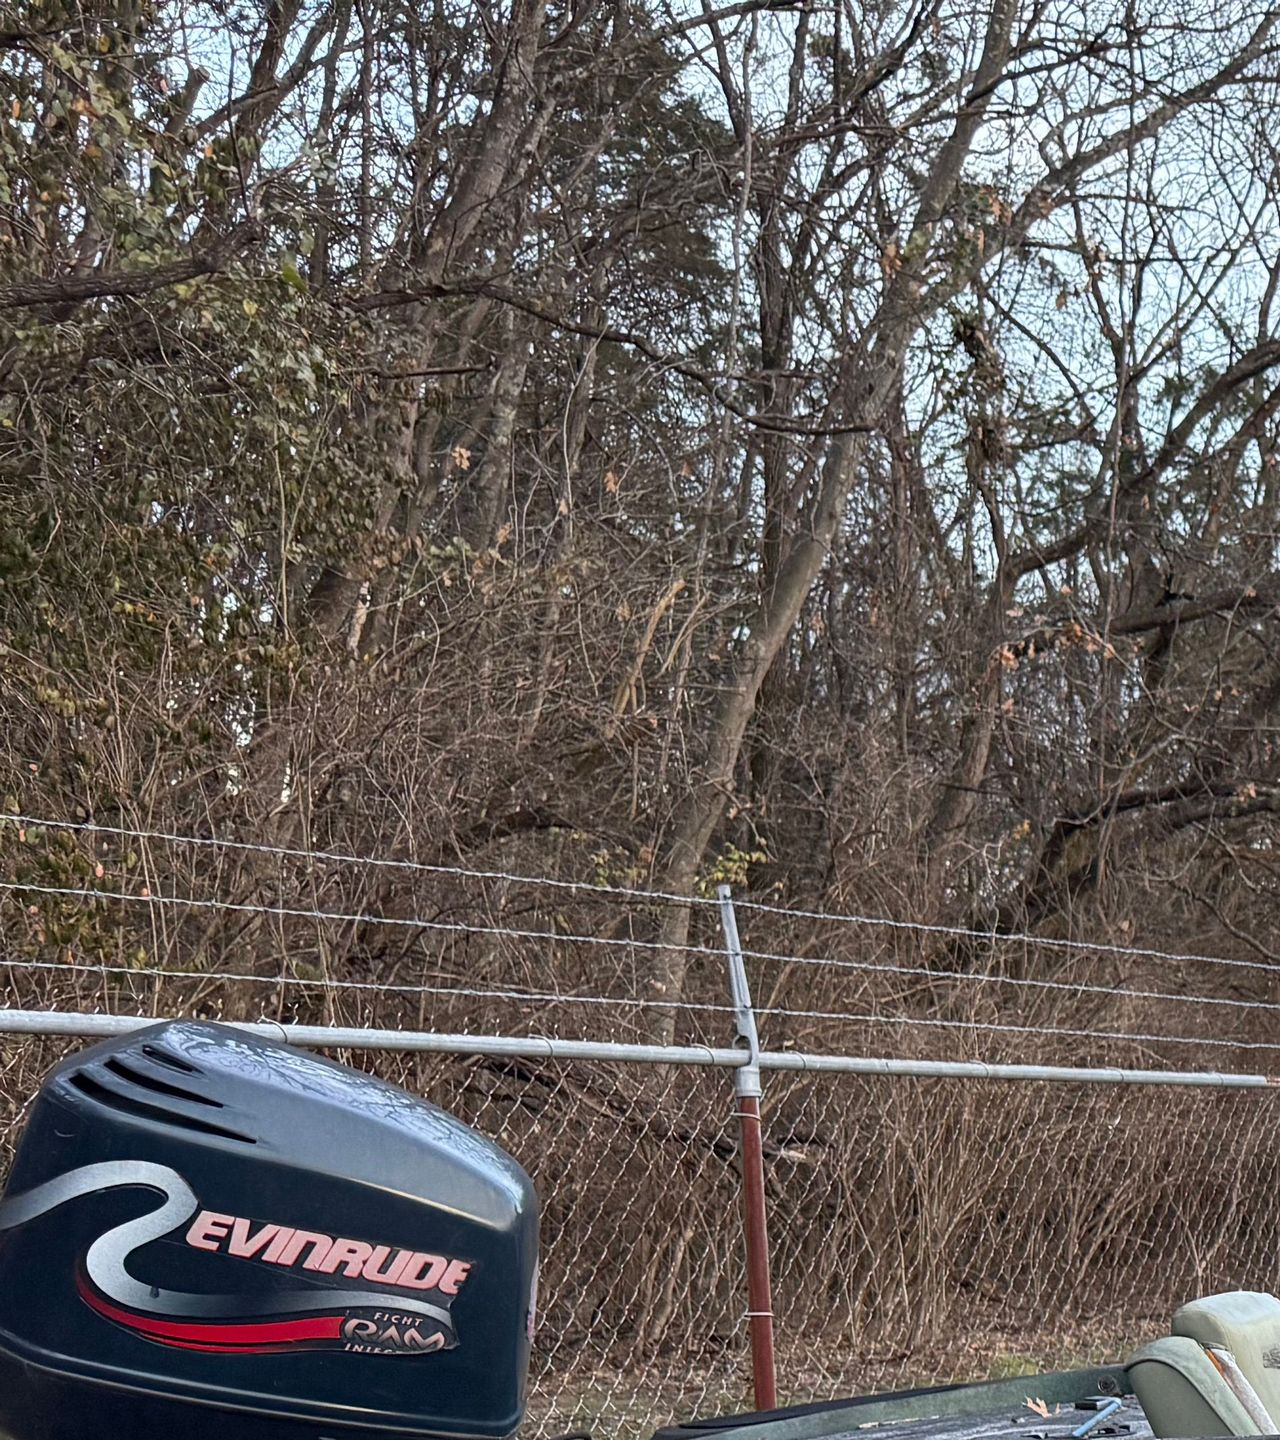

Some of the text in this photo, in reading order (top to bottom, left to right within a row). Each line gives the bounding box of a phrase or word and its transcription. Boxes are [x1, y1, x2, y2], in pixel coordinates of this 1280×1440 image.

[186, 1210, 471, 1295] EVINRUDE
[344, 1318, 445, 1350] RAM
[374, 1312, 424, 1327] FICHT
